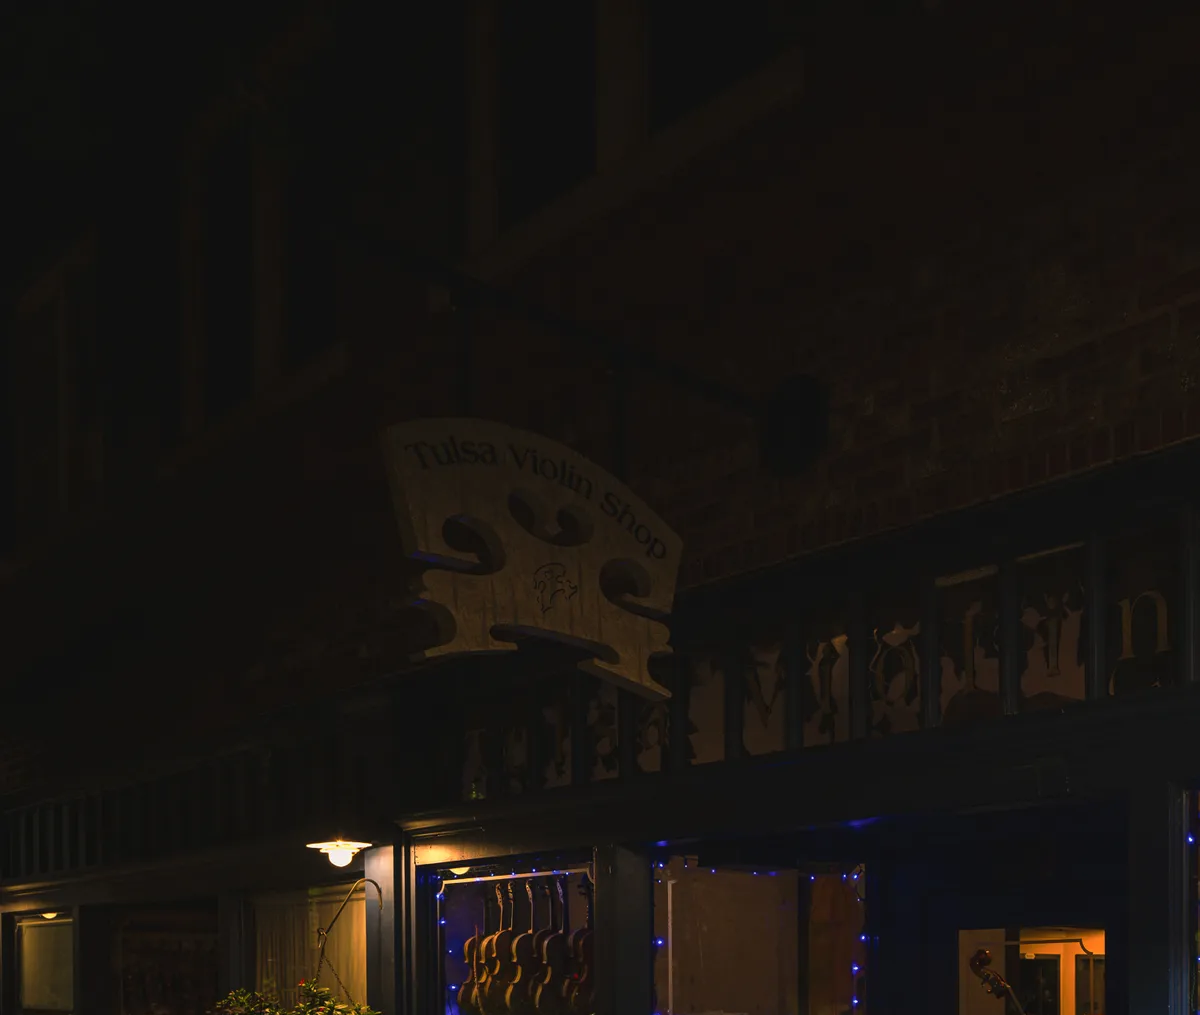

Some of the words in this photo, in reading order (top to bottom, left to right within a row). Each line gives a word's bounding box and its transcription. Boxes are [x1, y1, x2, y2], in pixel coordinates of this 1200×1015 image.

[403, 436, 498, 471] Tulsa
[506, 442, 593, 499] Violin
[600, 491, 667, 561] Shop
